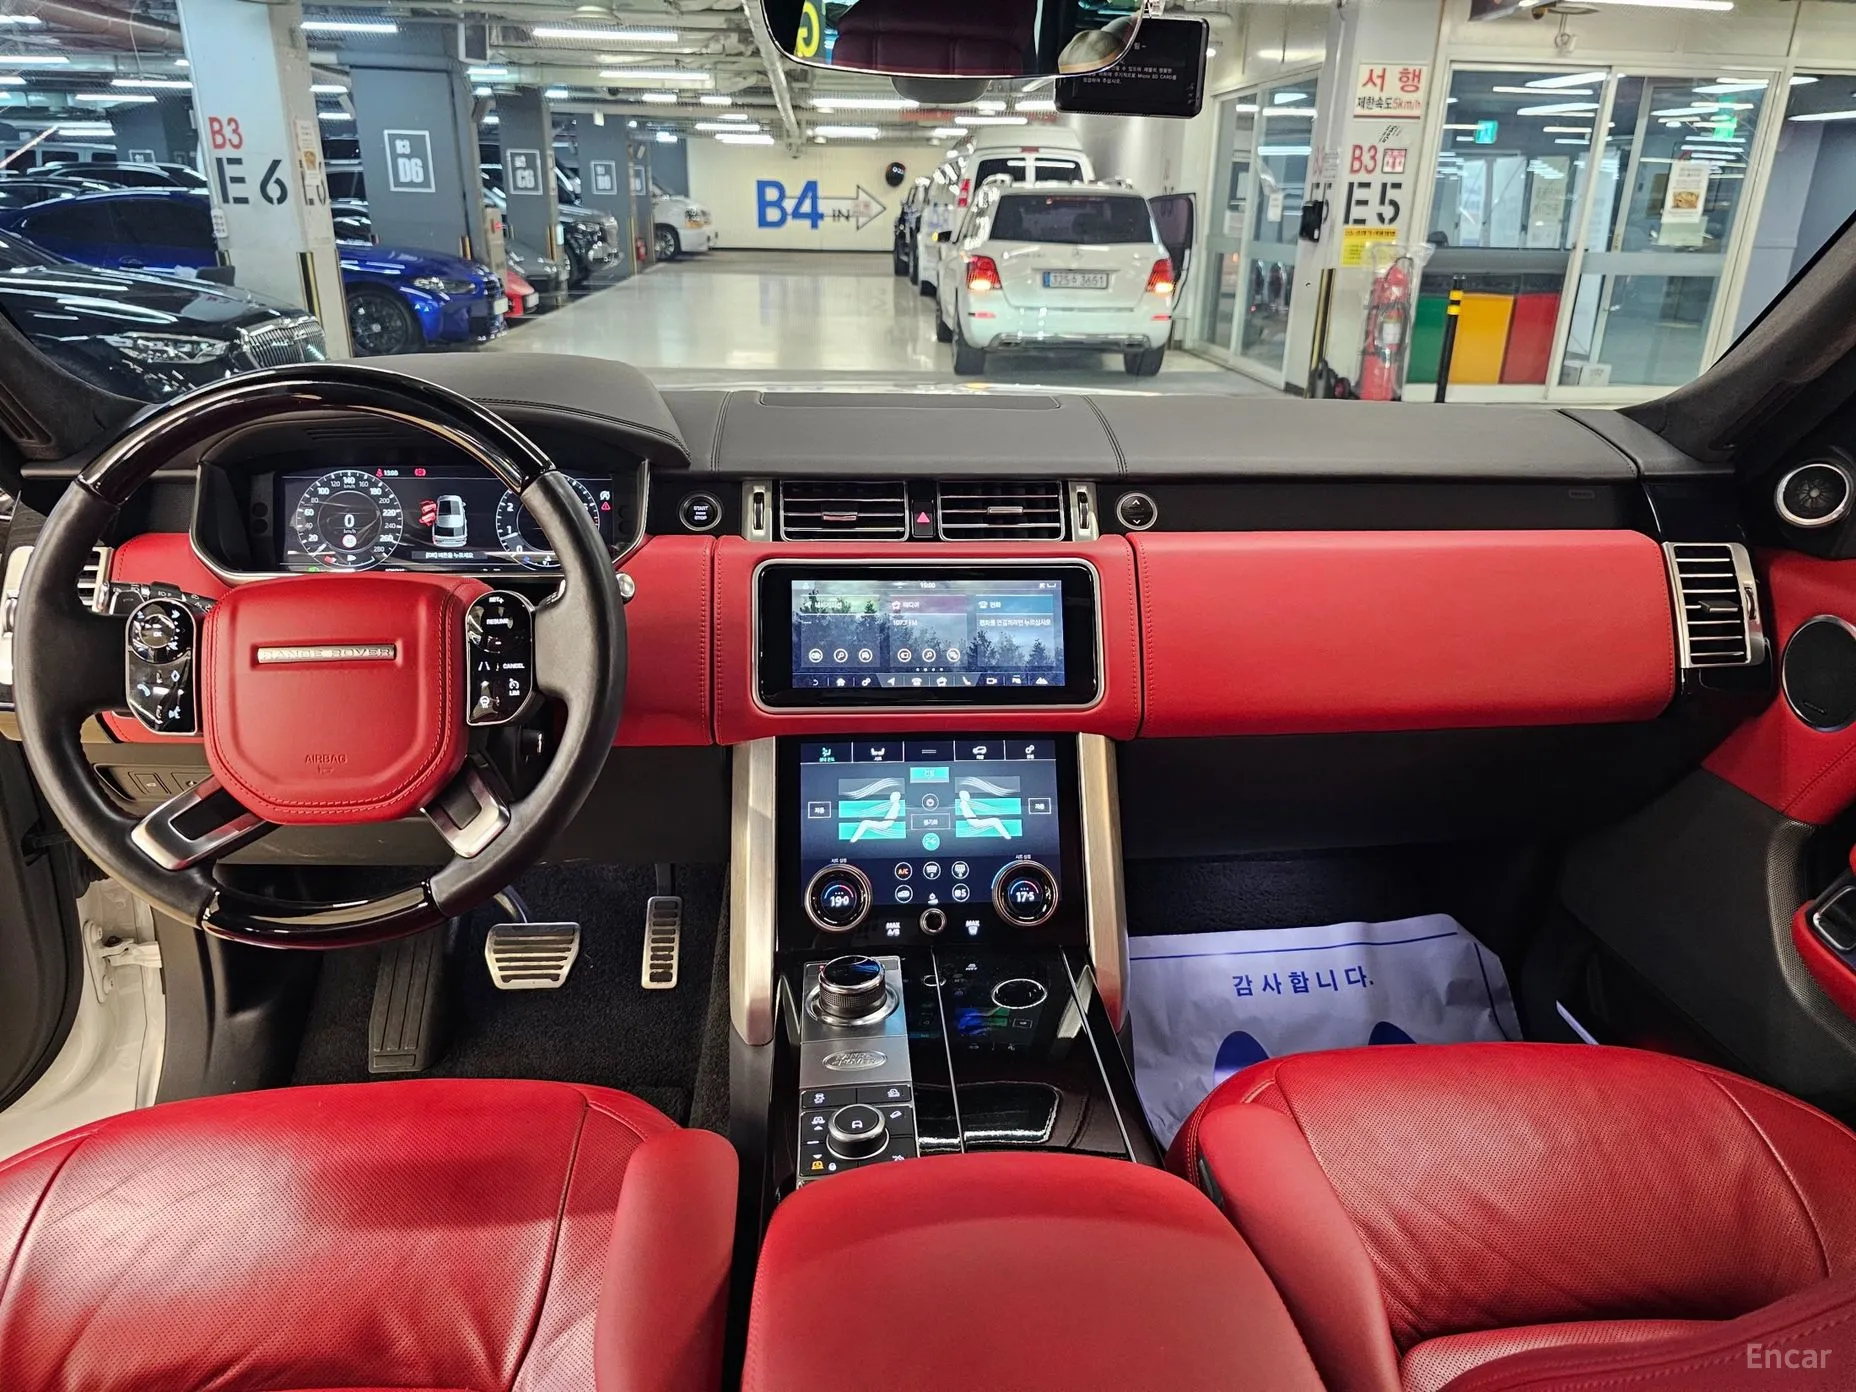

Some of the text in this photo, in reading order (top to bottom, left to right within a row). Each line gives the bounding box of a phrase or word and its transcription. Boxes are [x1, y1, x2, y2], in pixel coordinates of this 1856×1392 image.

[208, 116, 243, 150] B3
[1350, 144, 1378, 174] B3
[397, 157, 424, 183] D6
[756, 180, 850, 230] B4 IN
[1343, 182, 1402, 225] E5
[318, 487, 330, 495] 100
[370, 487, 382, 495] 180
[304, 508, 315, 516] 60
[506, 503, 514, 512] 2
[382, 509, 397, 517] 220
[344, 513, 355, 528] 0
[308, 534, 318, 542] 20
[380, 534, 393, 542] 260
[516, 545, 523, 553] 0
[331, 647, 391, 658] ROVER
[305, 754, 348, 764] AIRBAG
